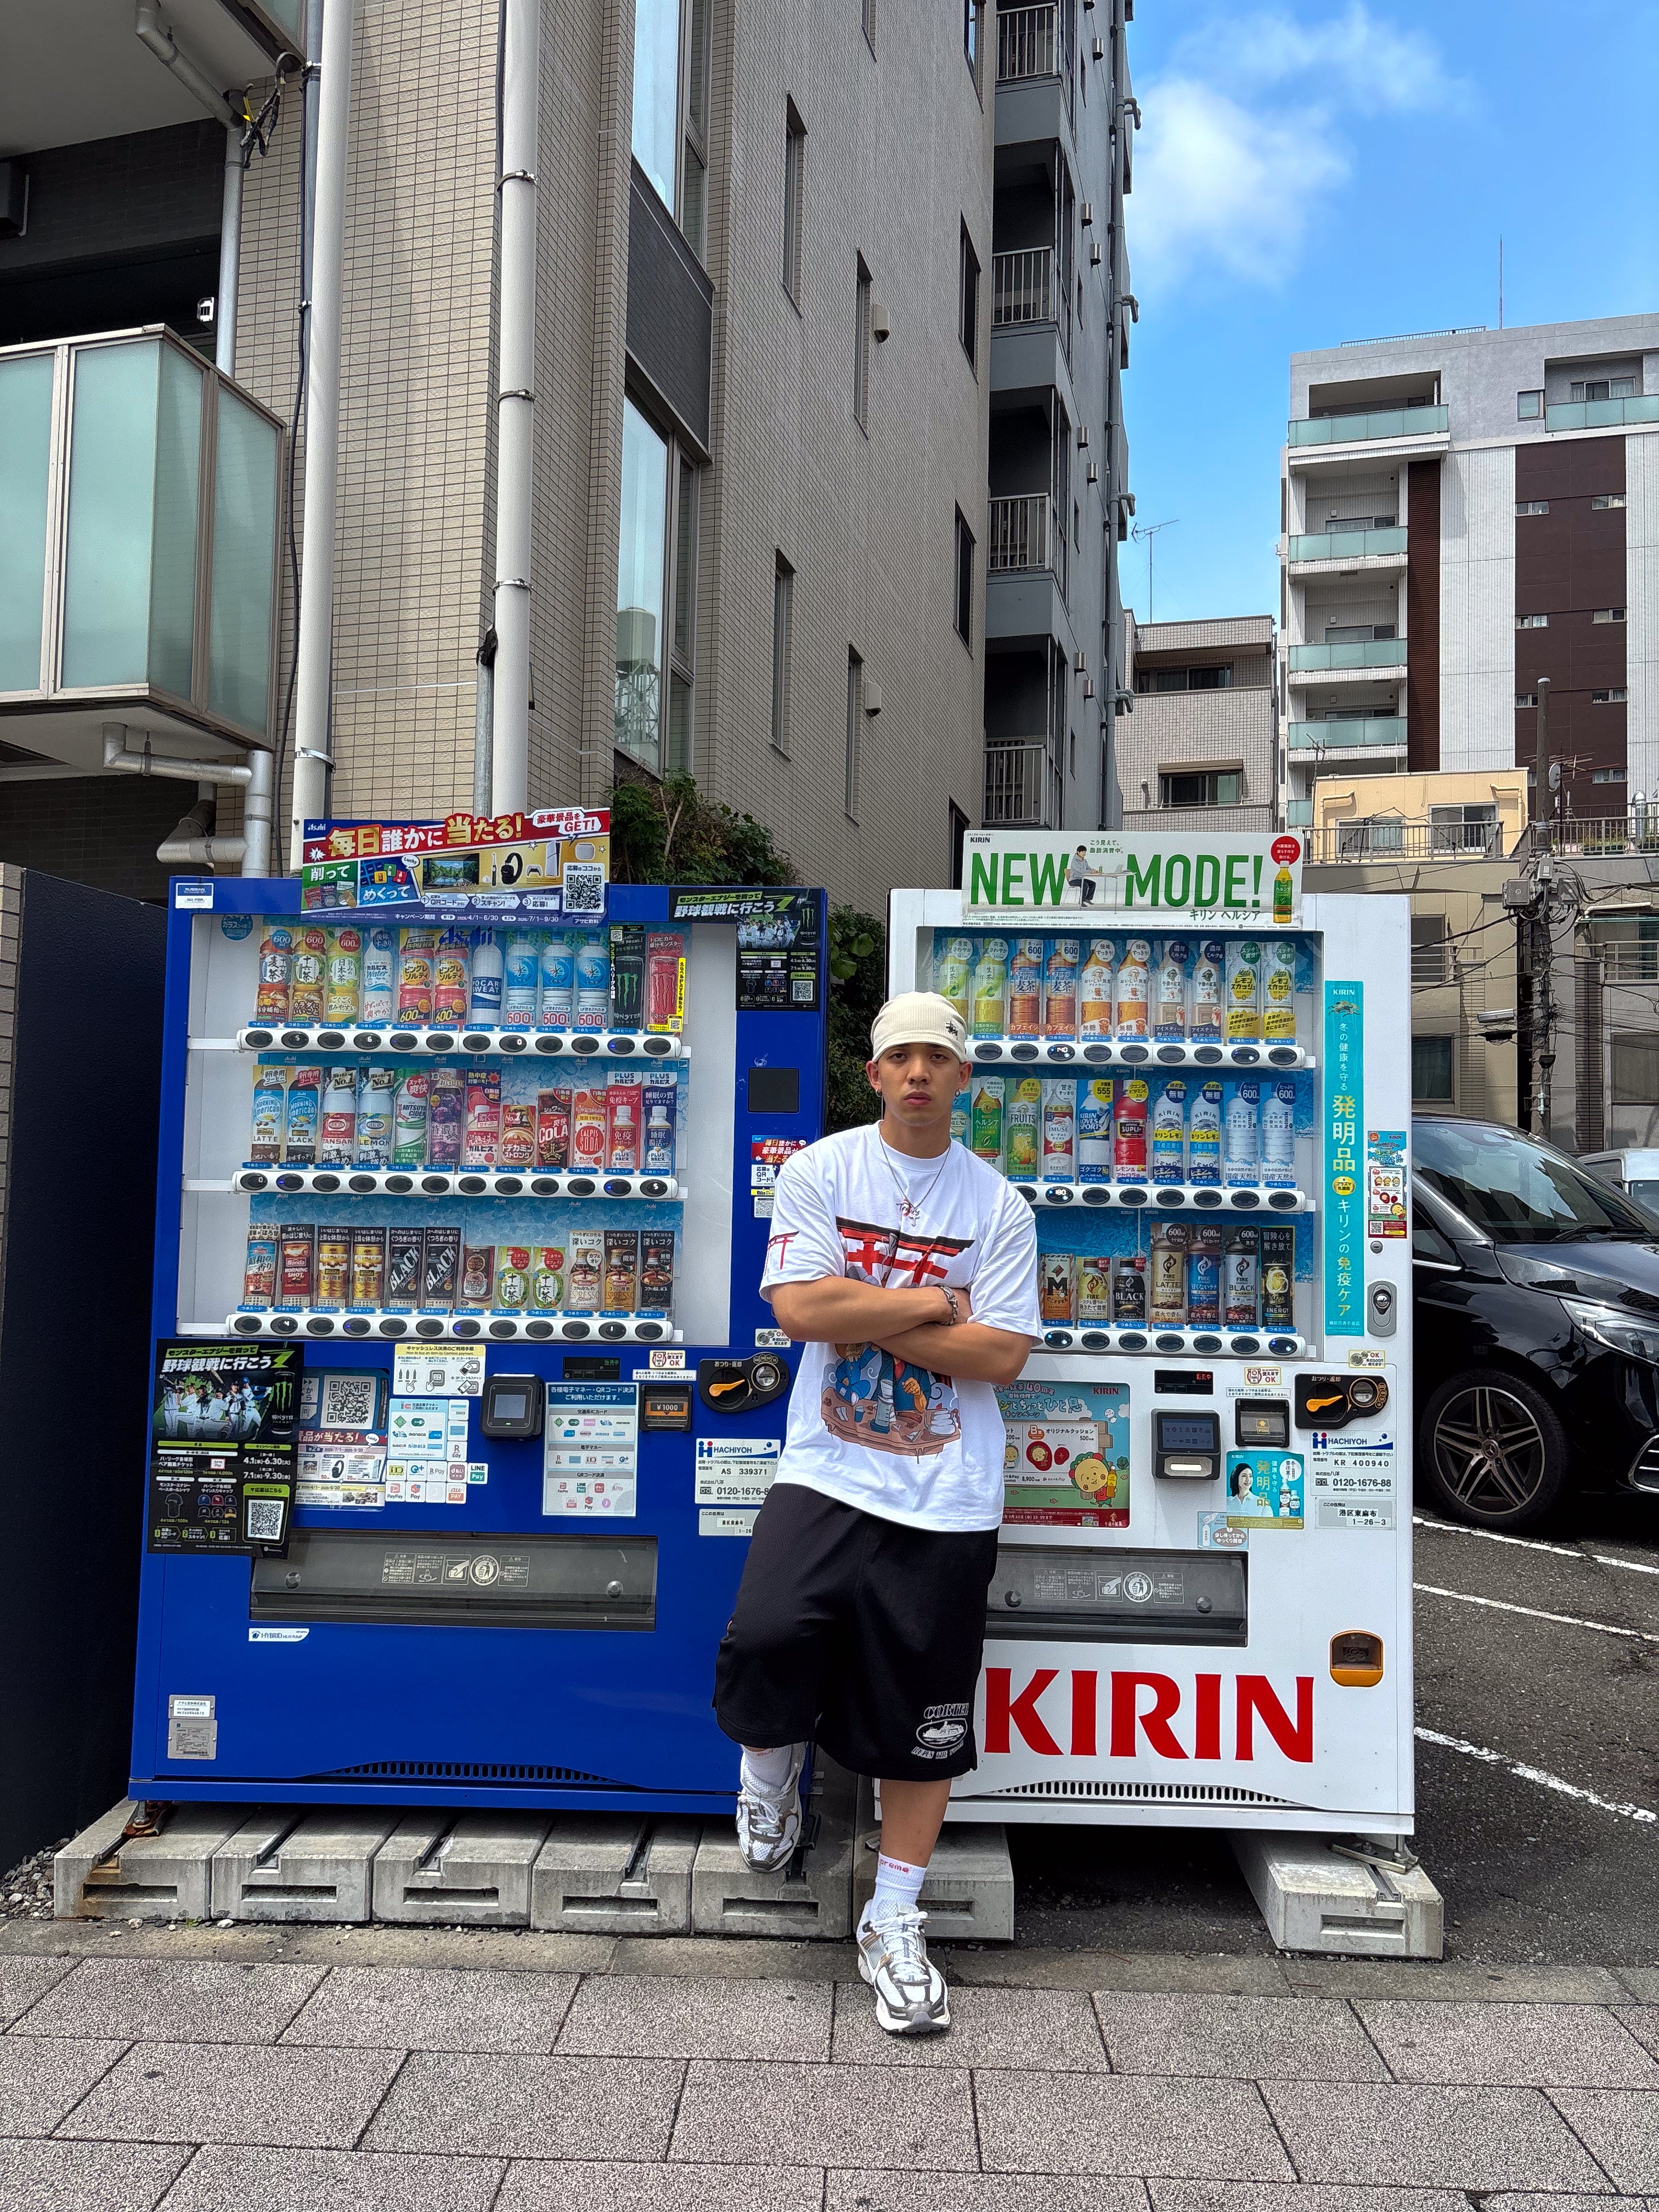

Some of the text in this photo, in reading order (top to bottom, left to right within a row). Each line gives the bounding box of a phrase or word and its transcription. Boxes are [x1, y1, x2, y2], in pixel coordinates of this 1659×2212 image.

[565, 820, 595, 832] GET!
[311, 865, 350, 881] 削って
[970, 853, 1070, 905] NEW
[1125, 854, 1263, 907] MODE!
[363, 885, 410, 901] めくって
[674, 901, 774, 917] 野球観戦に行こう
[1190, 909, 1261, 921] キリン ヘルシア
[1028, 946, 1042, 955] 600
[1064, 946, 1078, 955] 600
[268, 956, 280, 982] 麦茶
[302, 956, 313, 983] 十六茶
[337, 958, 346, 983] 日本茶
[1015, 981, 1036, 992] 麦茶
[1052, 981, 1073, 992] 麦茶
[1339, 1023, 1348, 1091] 冬の健康を守る
[334, 1072, 354, 1087] No.1
[372, 1072, 393, 1087] No.1
[409, 1085, 428, 1094] 爽快
[609, 1096, 639, 1104] 免疫キープ
[1011, 1114, 1035, 1123] FRUITS
[432, 1125, 450, 1135] 特濃
[539, 1126, 568, 1143] COLA
[580, 1129, 599, 1138] CALPIS
[614, 1131, 632, 1140] 免疫
[1332, 1094, 1356, 1172] 発明品
[580, 1138, 599, 1152] SODA
[606, 1238, 636, 1246] 深いコク
[643, 1238, 673, 1246] 深いコク
[1263, 1232, 1290, 1240] 冒険心を
[1337, 1199, 1352, 1317] キリンの免疫ケア
[390, 1246, 420, 1291] BLACK
[426, 1246, 456, 1292] BLACK
[504, 1273, 519, 1302] 十六茶
[1116, 1292, 1144, 1300] BLACK
[162, 1356, 272, 1373] 野球観戦に行こう
[1333, 1479, 1391, 1487] 0120-1676-88
[984, 1667, 1314, 1763] KIRIN
[879, 1859, 909, 1873] preme
